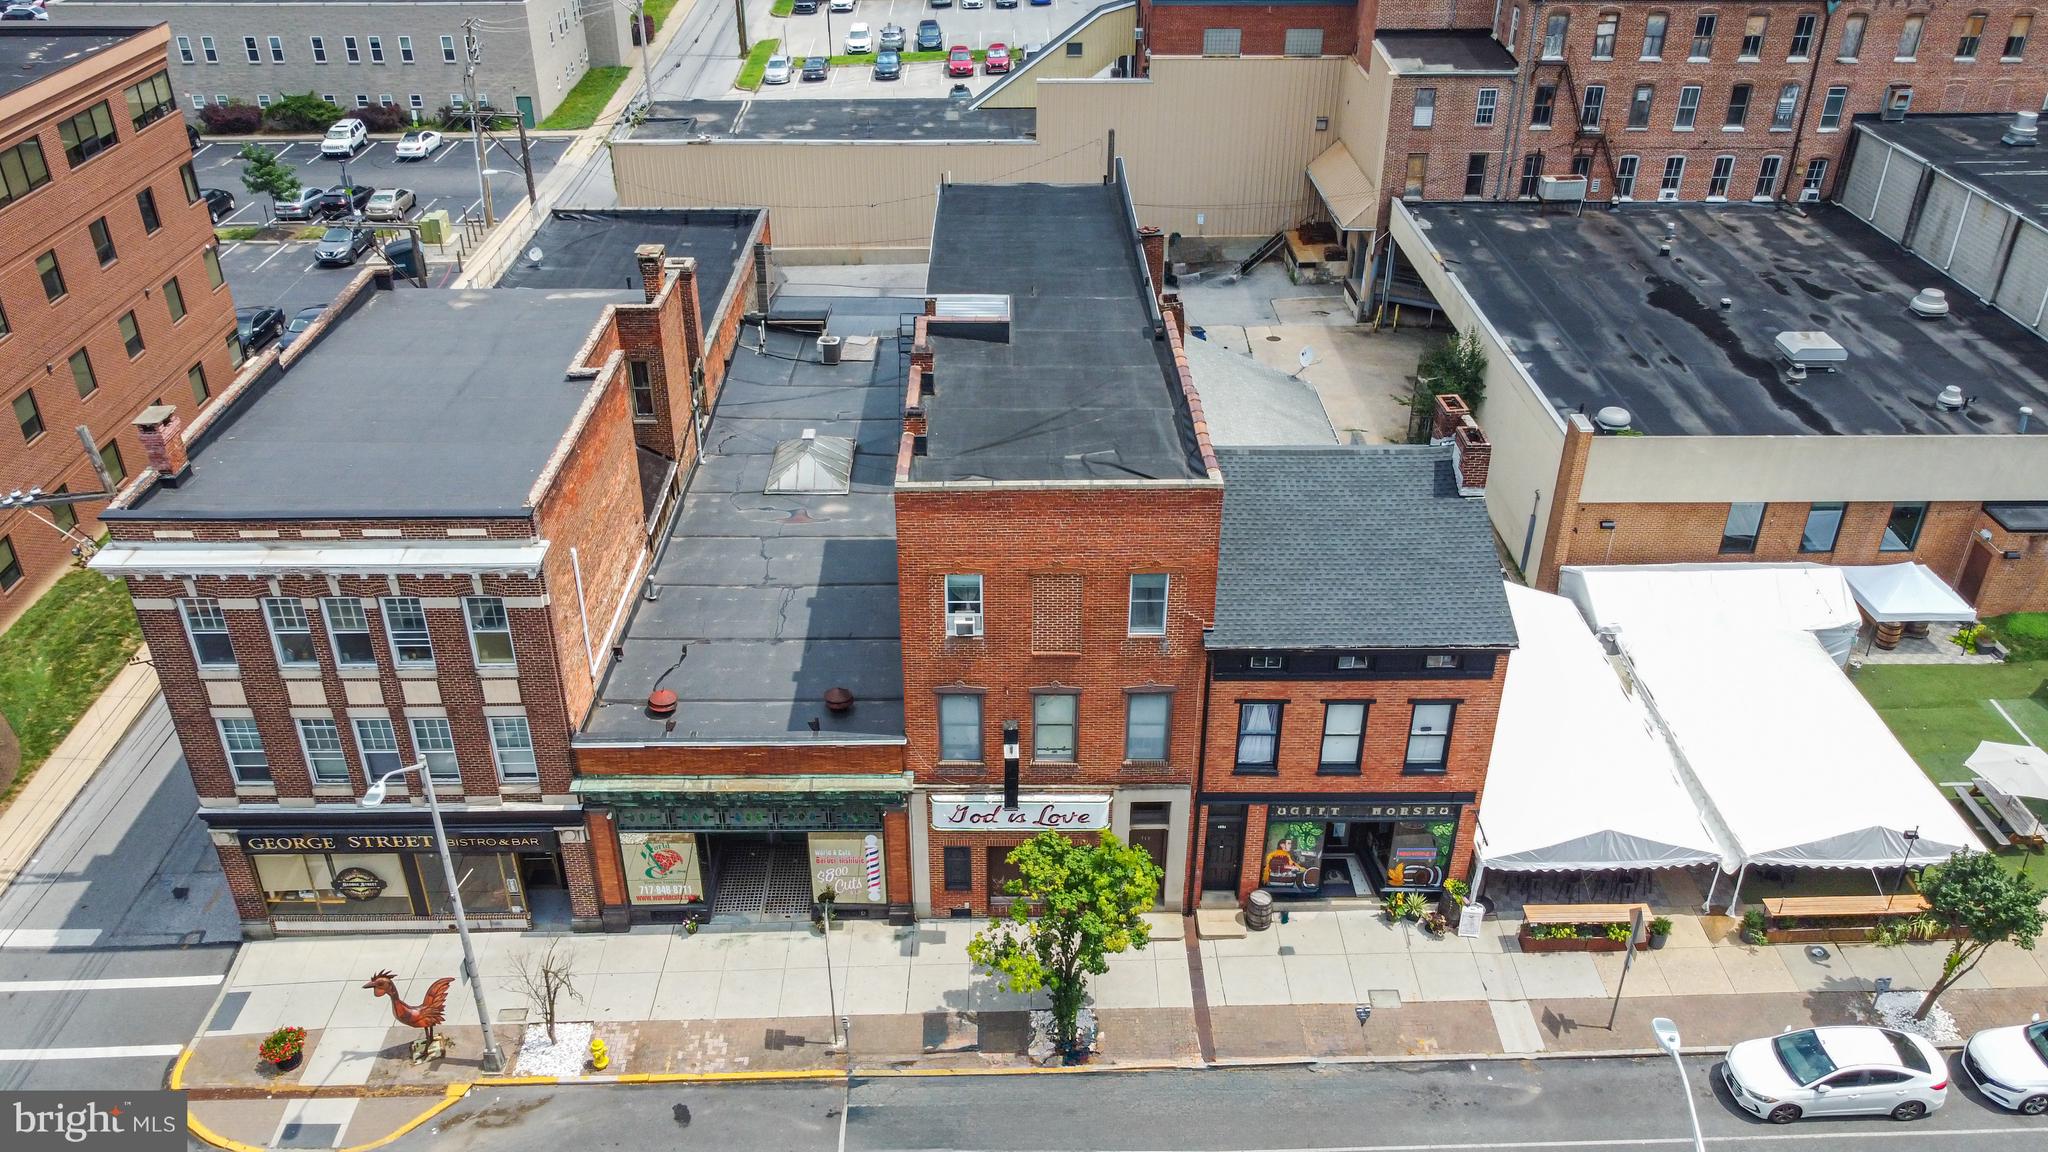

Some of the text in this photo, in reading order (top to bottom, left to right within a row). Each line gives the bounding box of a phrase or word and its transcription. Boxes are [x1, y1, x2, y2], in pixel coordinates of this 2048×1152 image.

[948, 804, 1090, 826] God is Love
[248, 835, 540, 850] GEORGE STREET BISTRO & BAR
[834, 876, 863, 894] Cuts
